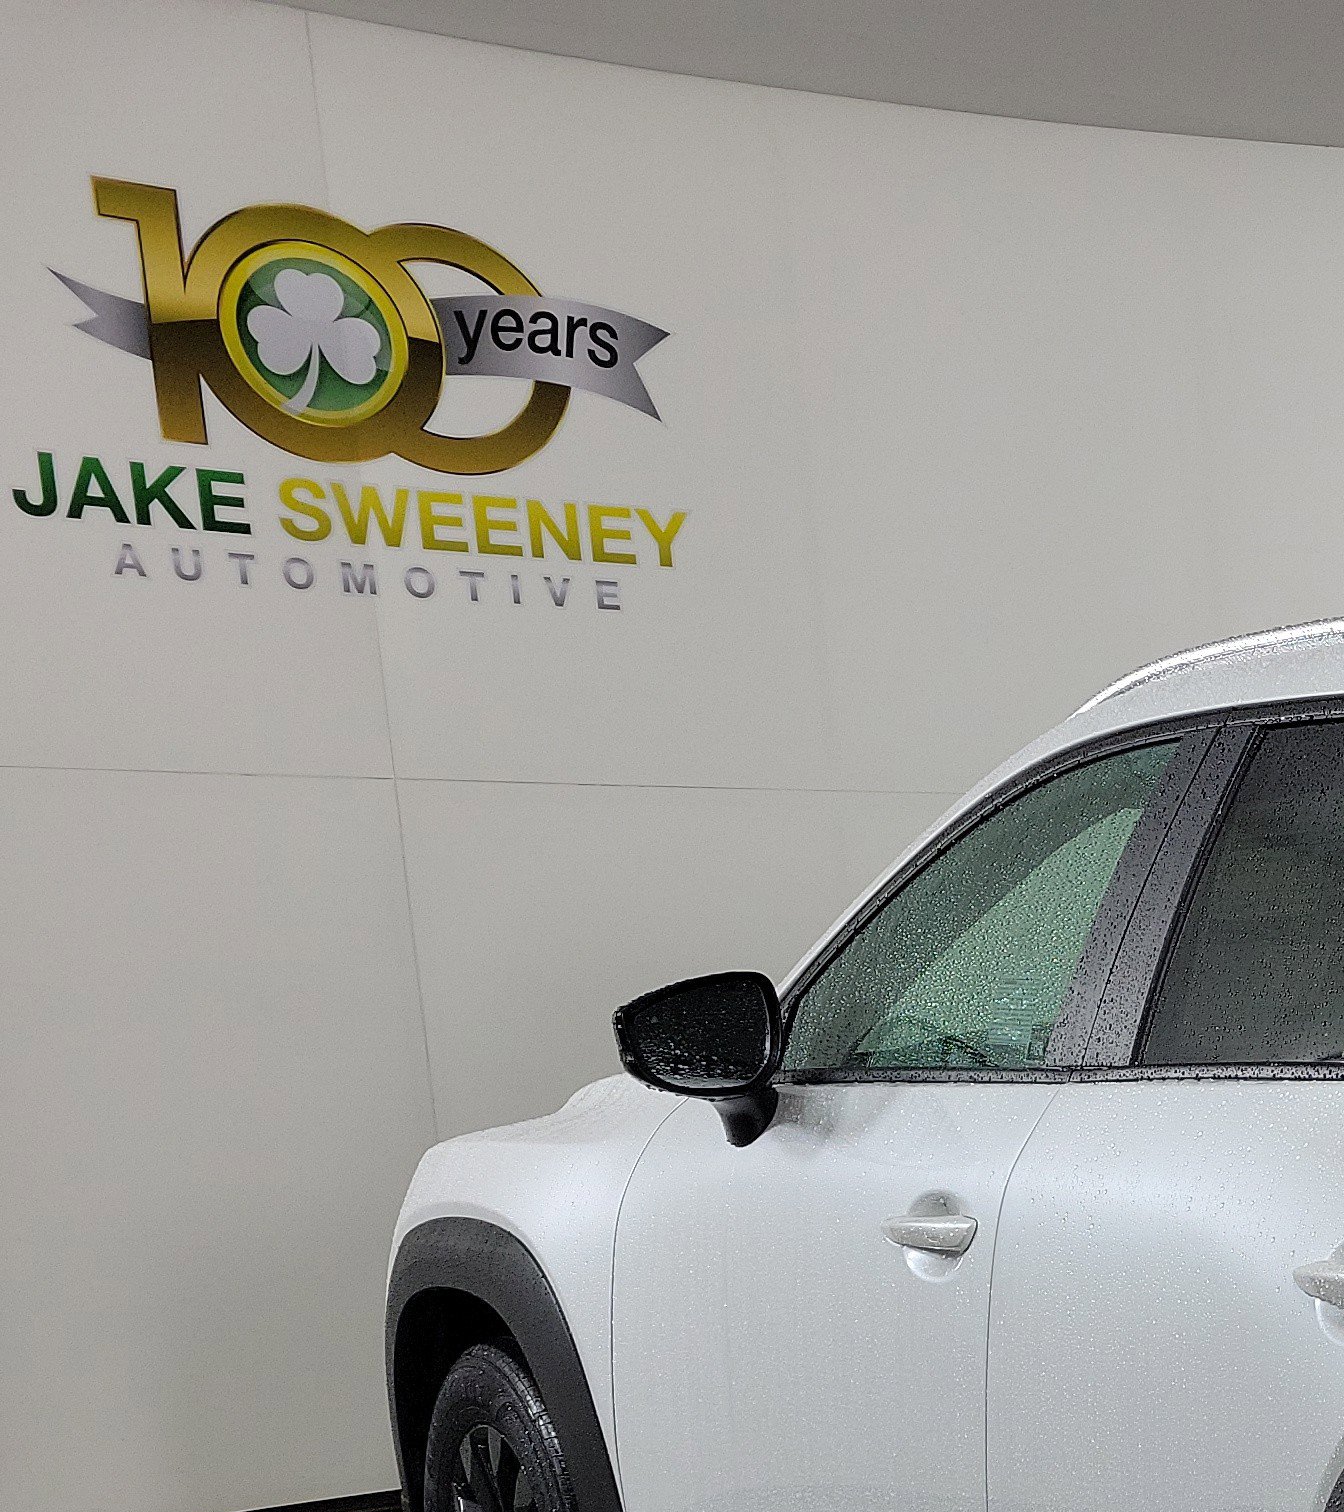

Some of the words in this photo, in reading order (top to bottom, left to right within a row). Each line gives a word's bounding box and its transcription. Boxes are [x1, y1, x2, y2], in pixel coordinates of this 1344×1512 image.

[91, 175, 571, 475] 100
[453, 307, 620, 369] years
[12, 451, 251, 535] JAKE
[277, 478, 688, 567] SWEENEY
[114, 543, 621, 611] AUTOMOTIVE
